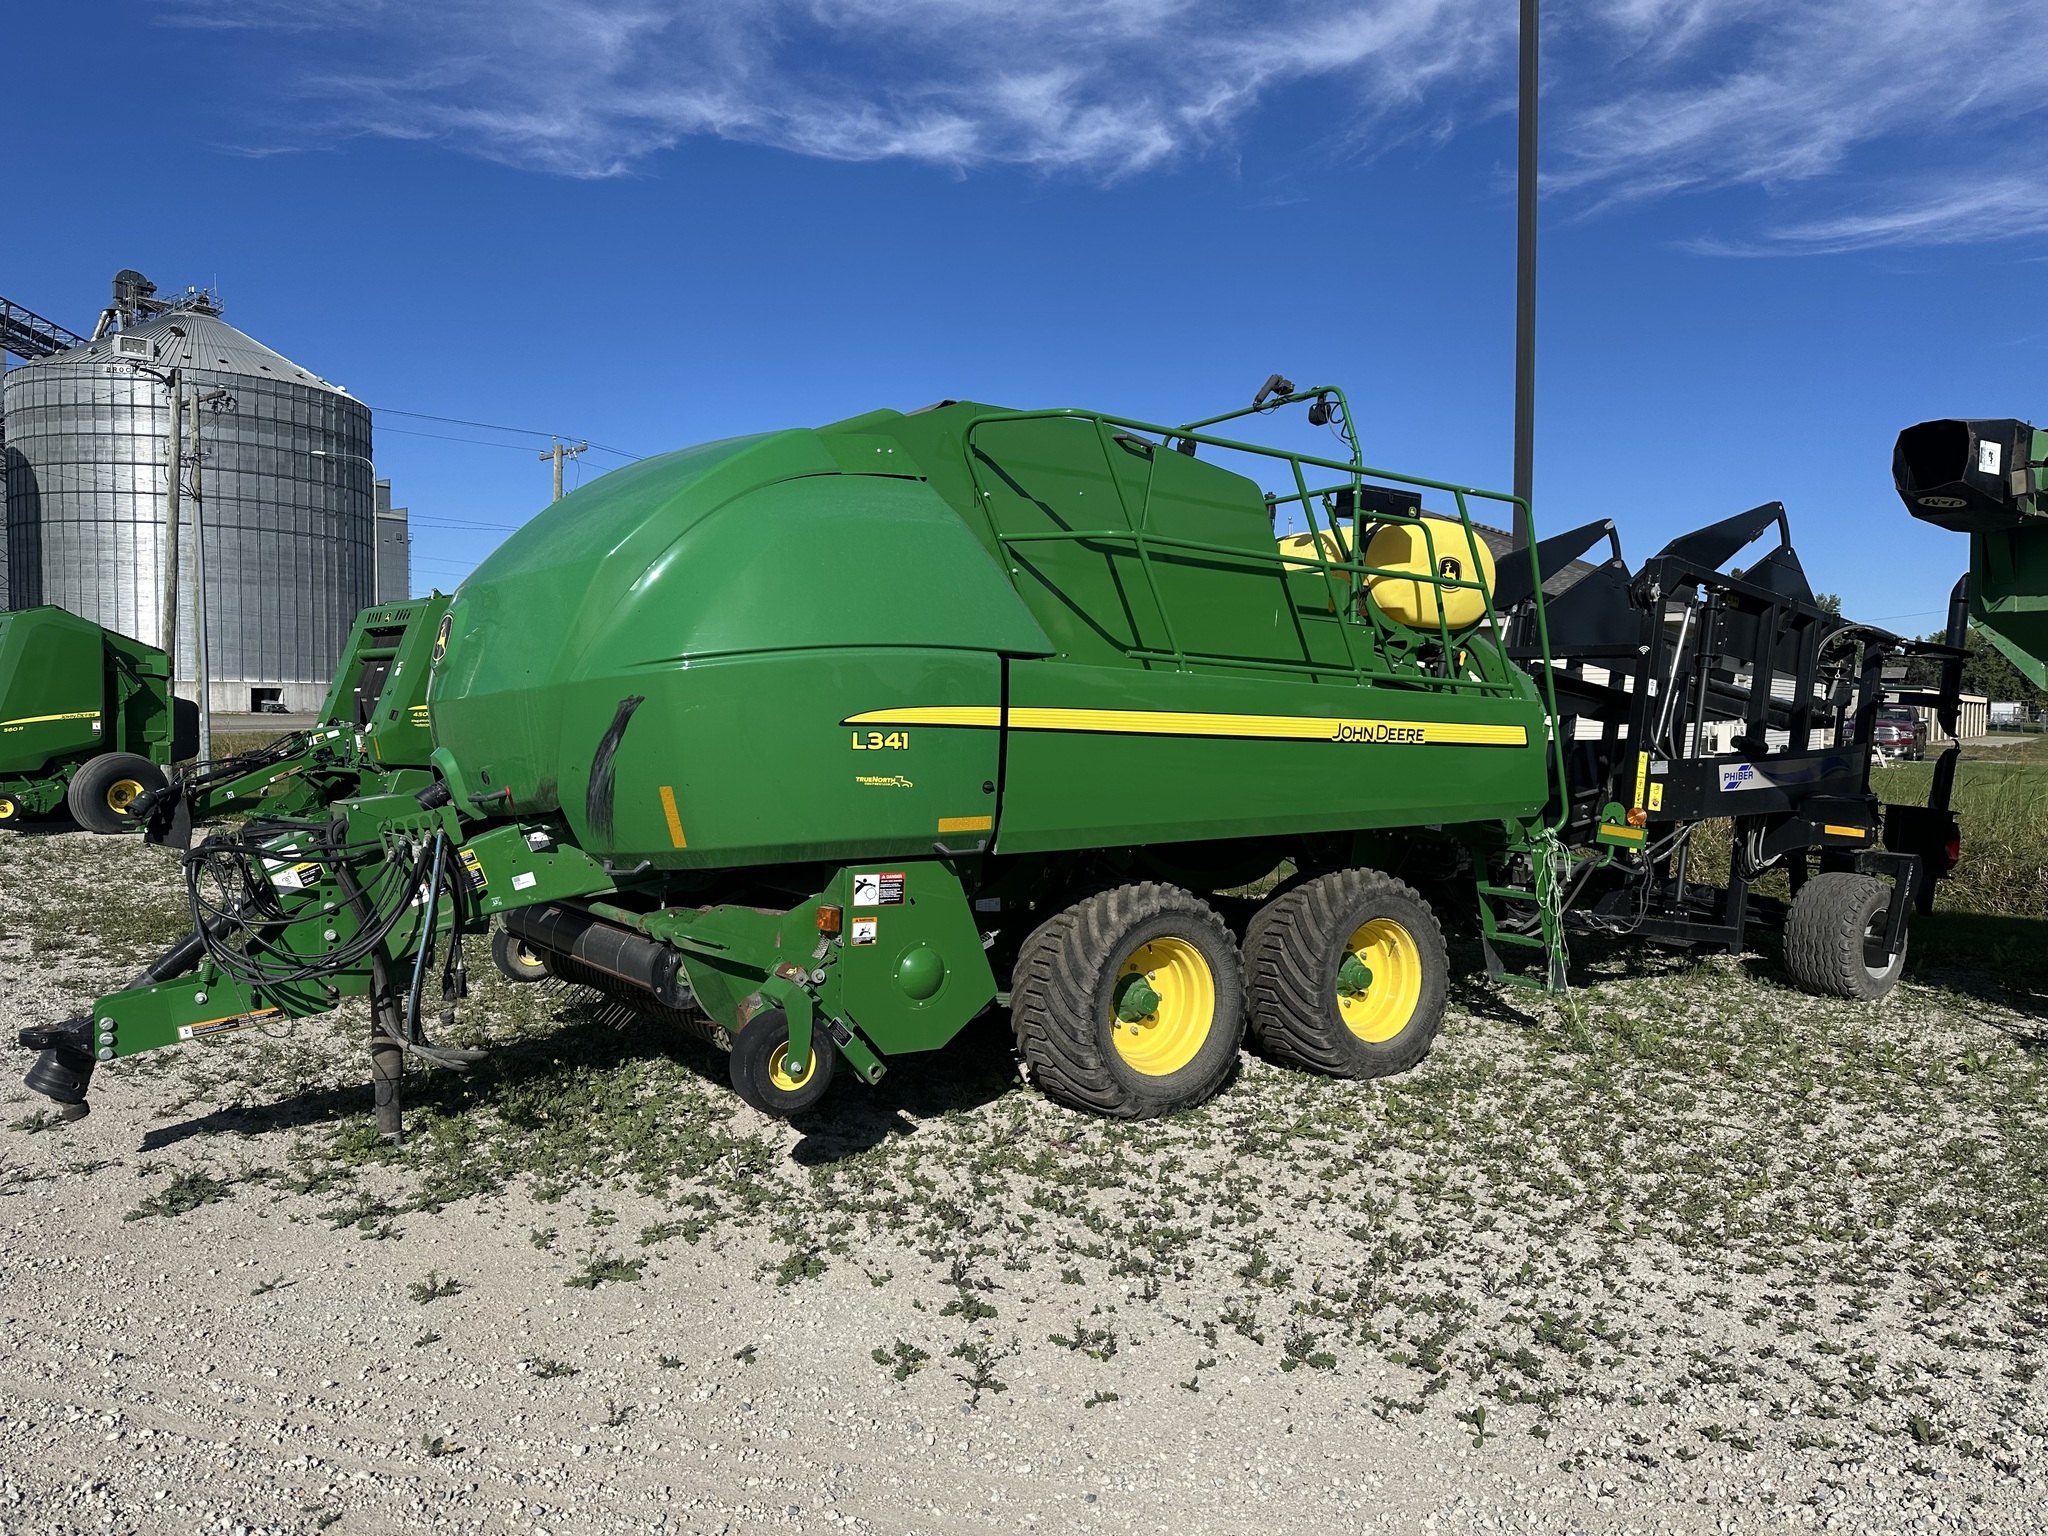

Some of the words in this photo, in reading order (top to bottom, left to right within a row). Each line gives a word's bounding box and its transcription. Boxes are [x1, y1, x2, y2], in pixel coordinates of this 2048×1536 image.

[852, 731, 909, 750] L341
[1332, 722, 1375, 740] JOHN
[1376, 724, 1425, 742] DEERE
[1723, 770, 1754, 781] PHIBER
